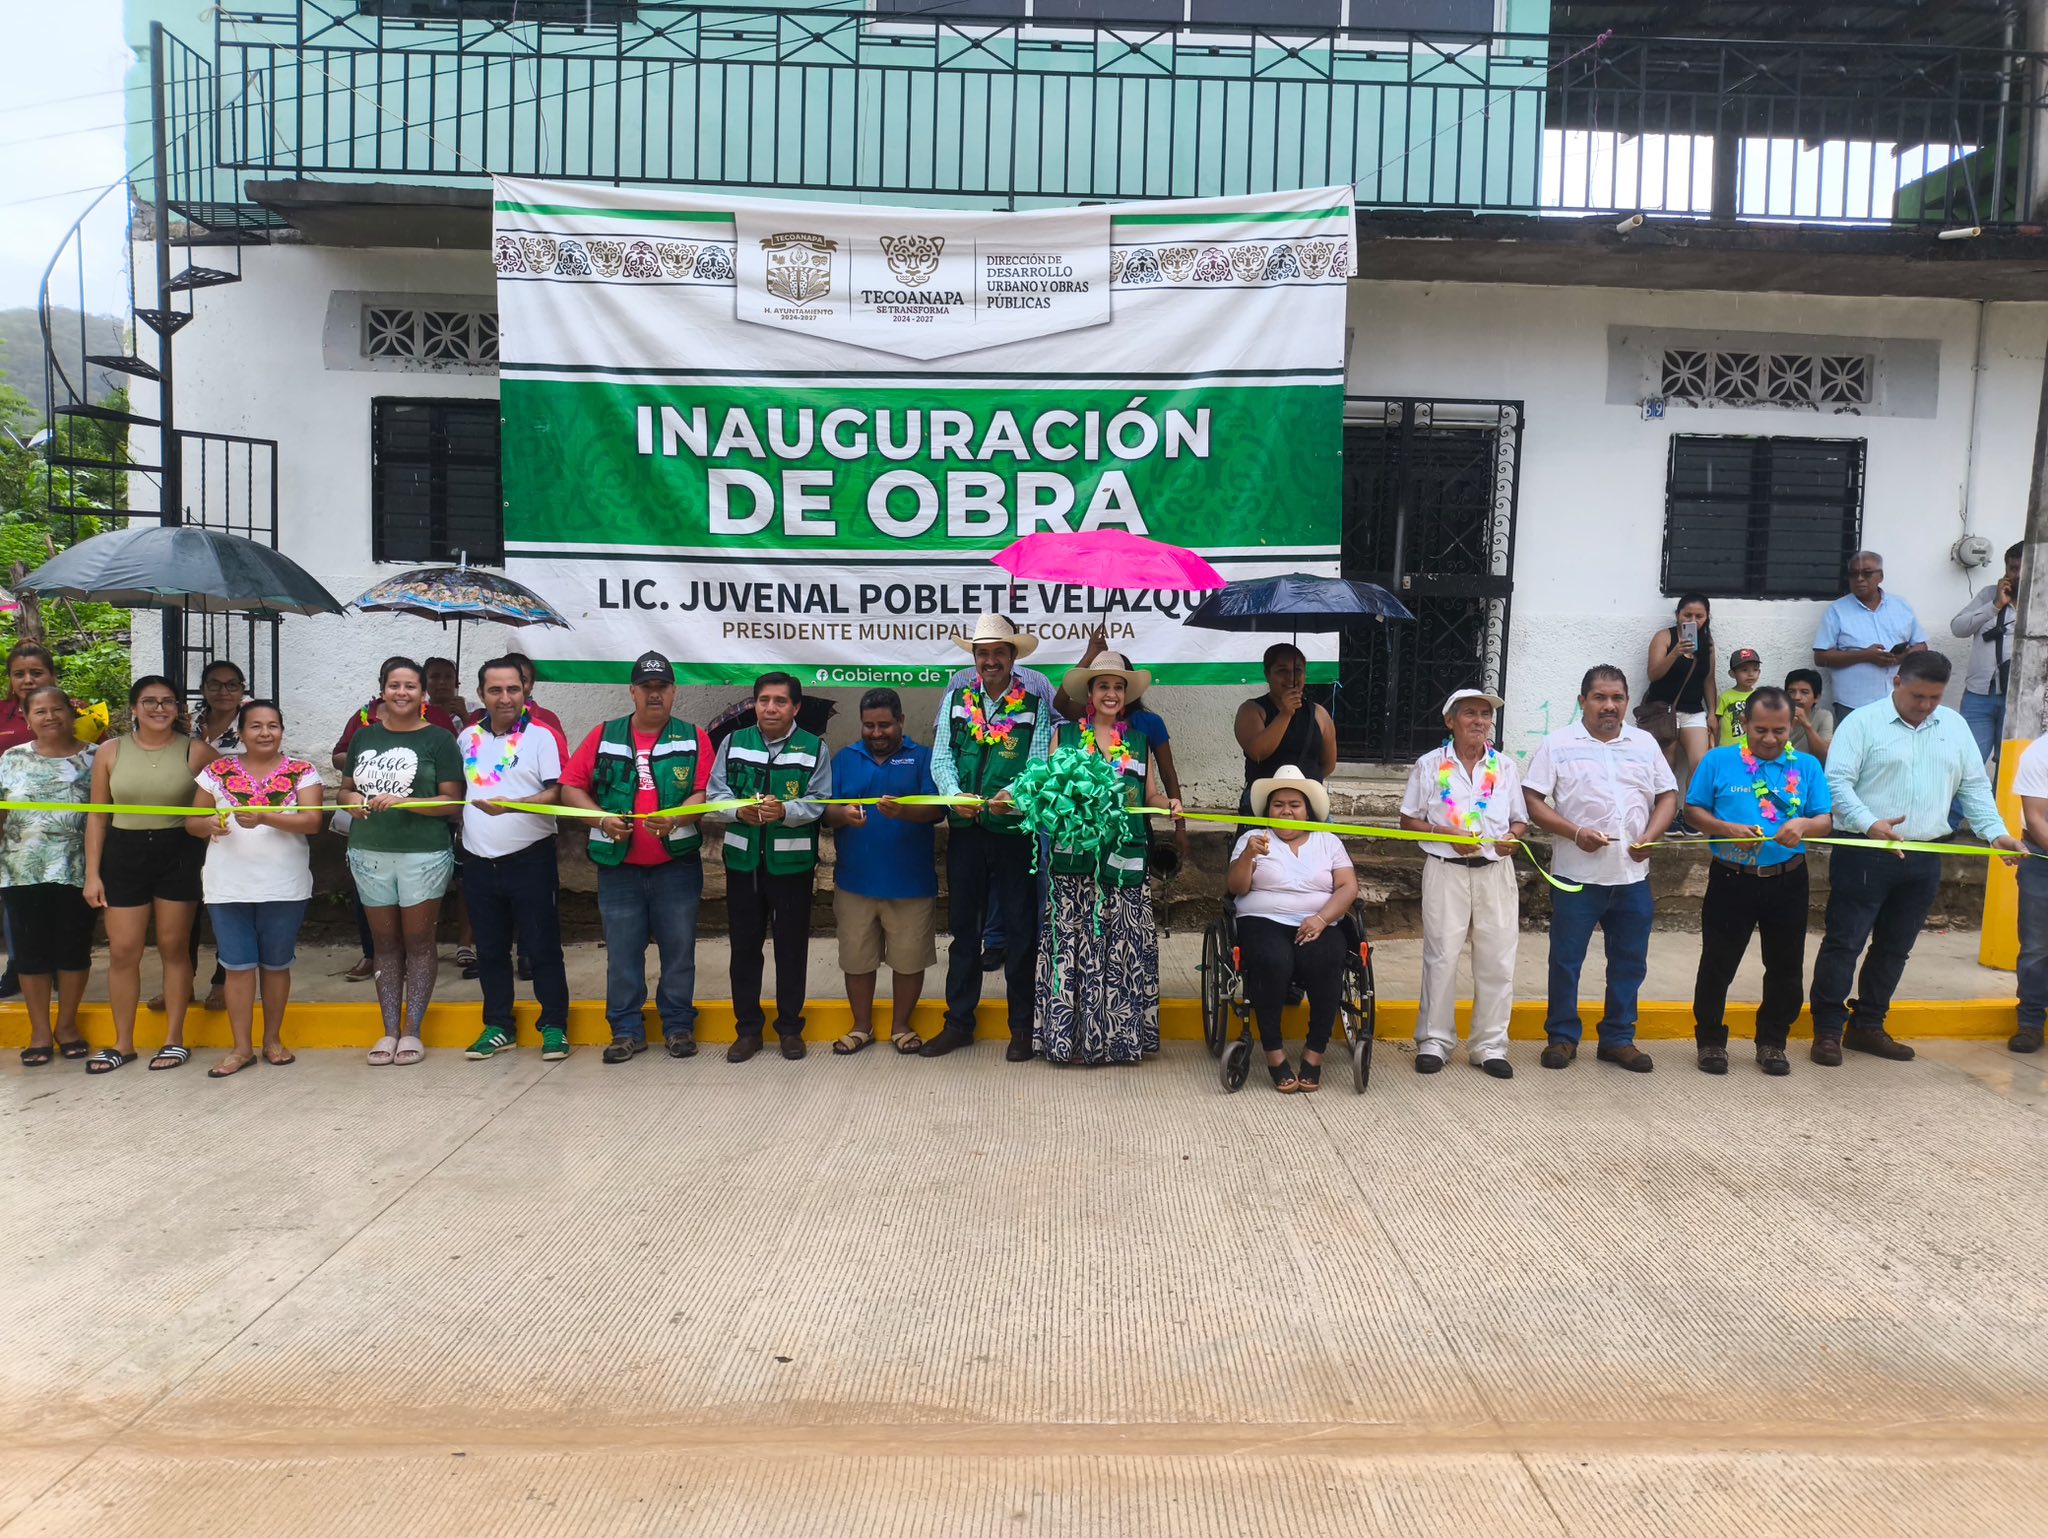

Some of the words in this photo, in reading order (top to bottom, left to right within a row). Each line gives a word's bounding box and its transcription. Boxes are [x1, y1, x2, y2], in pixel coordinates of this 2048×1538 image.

[775, 233, 823, 244] TECOANAPA
[986, 253, 1046, 266] DIRECCIÓN
[1047, 255, 1063, 265] DE
[986, 266, 1073, 278] DESARROLLO
[986, 280, 1039, 293] URBANO
[1040, 281, 1050, 293] Y
[1050, 280, 1090, 293] OBRAS
[860, 290, 965, 305] TECOANAPA
[986, 293, 1051, 309] PÚBLICAS
[774, 307, 834, 316] AYUNTAMIENTO
[637, 396, 1211, 462] INAUGURACIÓN
[707, 468, 837, 537] DE
[867, 469, 1150, 538] OBRA
[598, 578, 669, 611] LIC.
[679, 580, 850, 614] JUVENAL
[859, 582, 1029, 615] POBLETE
[1037, 583, 1208, 620] VELAZQU
[722, 621, 853, 641] PRESIDENTE
[859, 622, 973, 641] MUNICIPAL
[831, 668, 914, 682] Gobierno
[918, 668, 941, 682] de
[1730, 785, 1751, 793] Uriel
